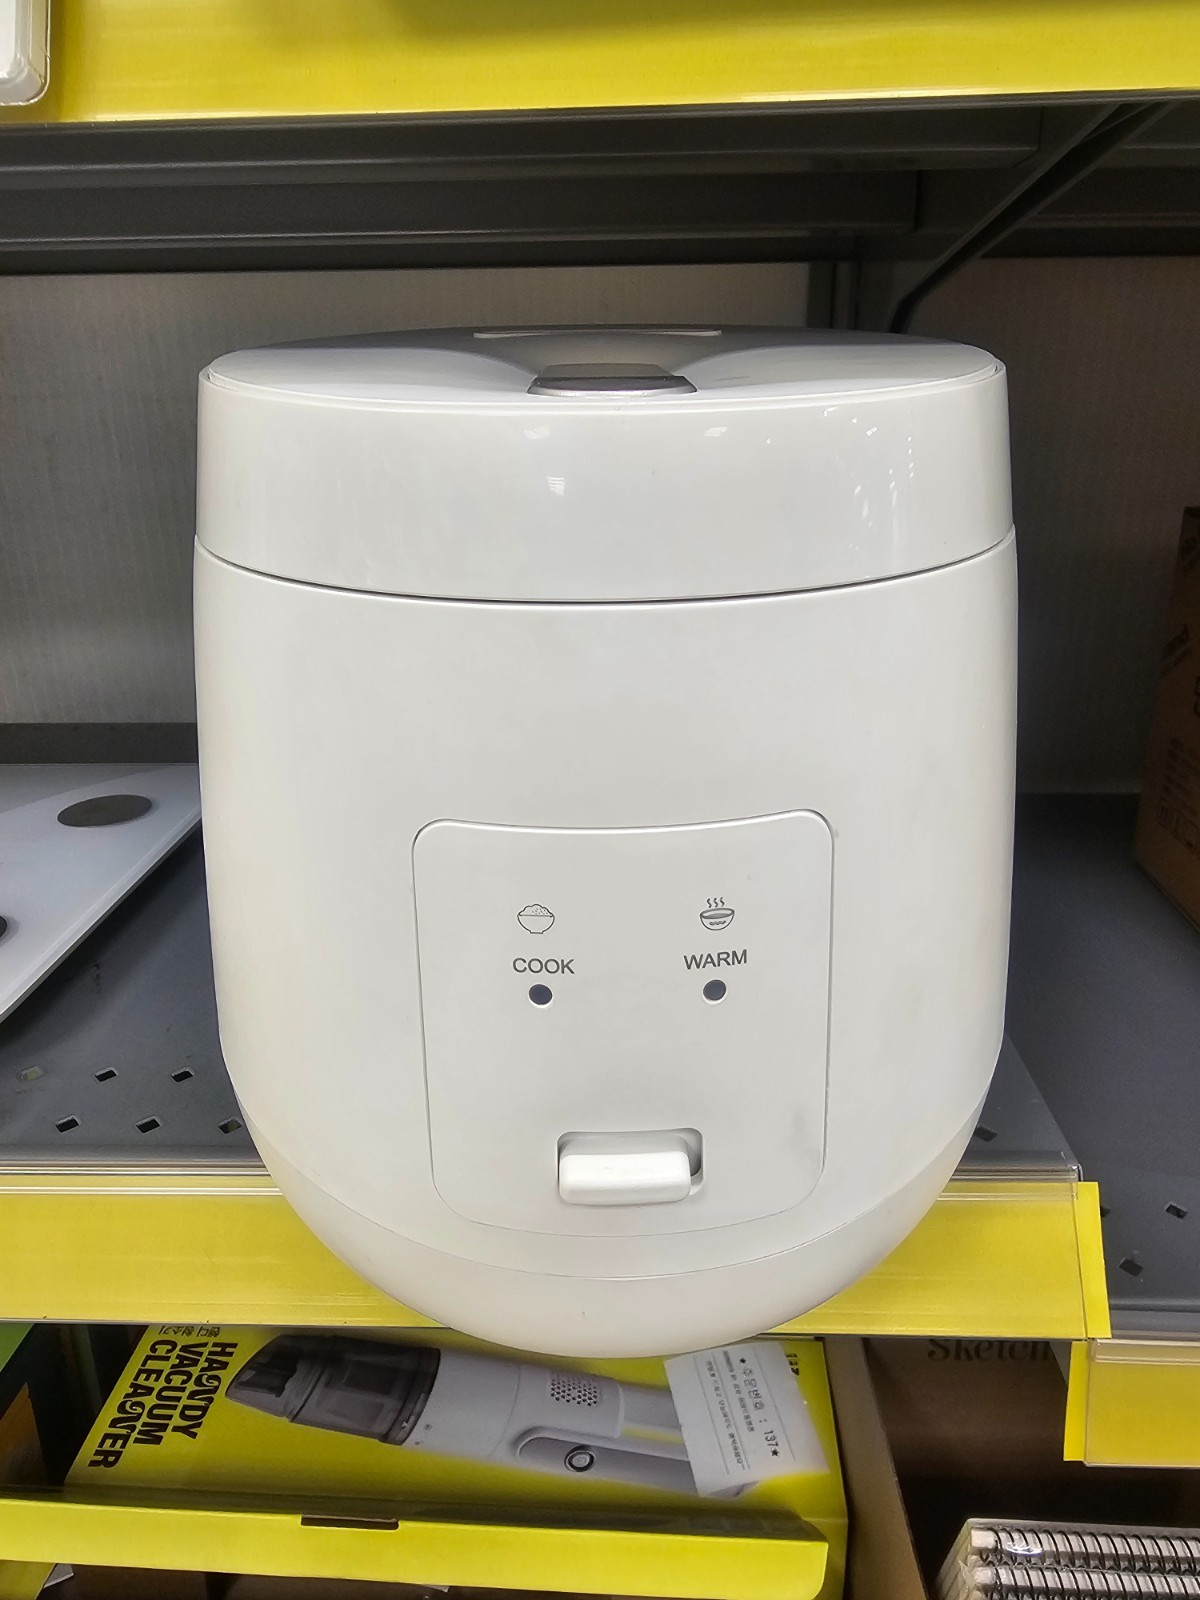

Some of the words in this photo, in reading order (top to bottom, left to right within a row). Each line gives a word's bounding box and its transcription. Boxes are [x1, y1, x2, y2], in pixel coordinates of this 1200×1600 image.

[512, 957, 575, 974] COOK
[683, 949, 748, 970] WARM
[87, 1339, 178, 1469] CLEANER
[133, 1341, 209, 1446] VACUUM
[171, 1341, 239, 1440] HANDY
